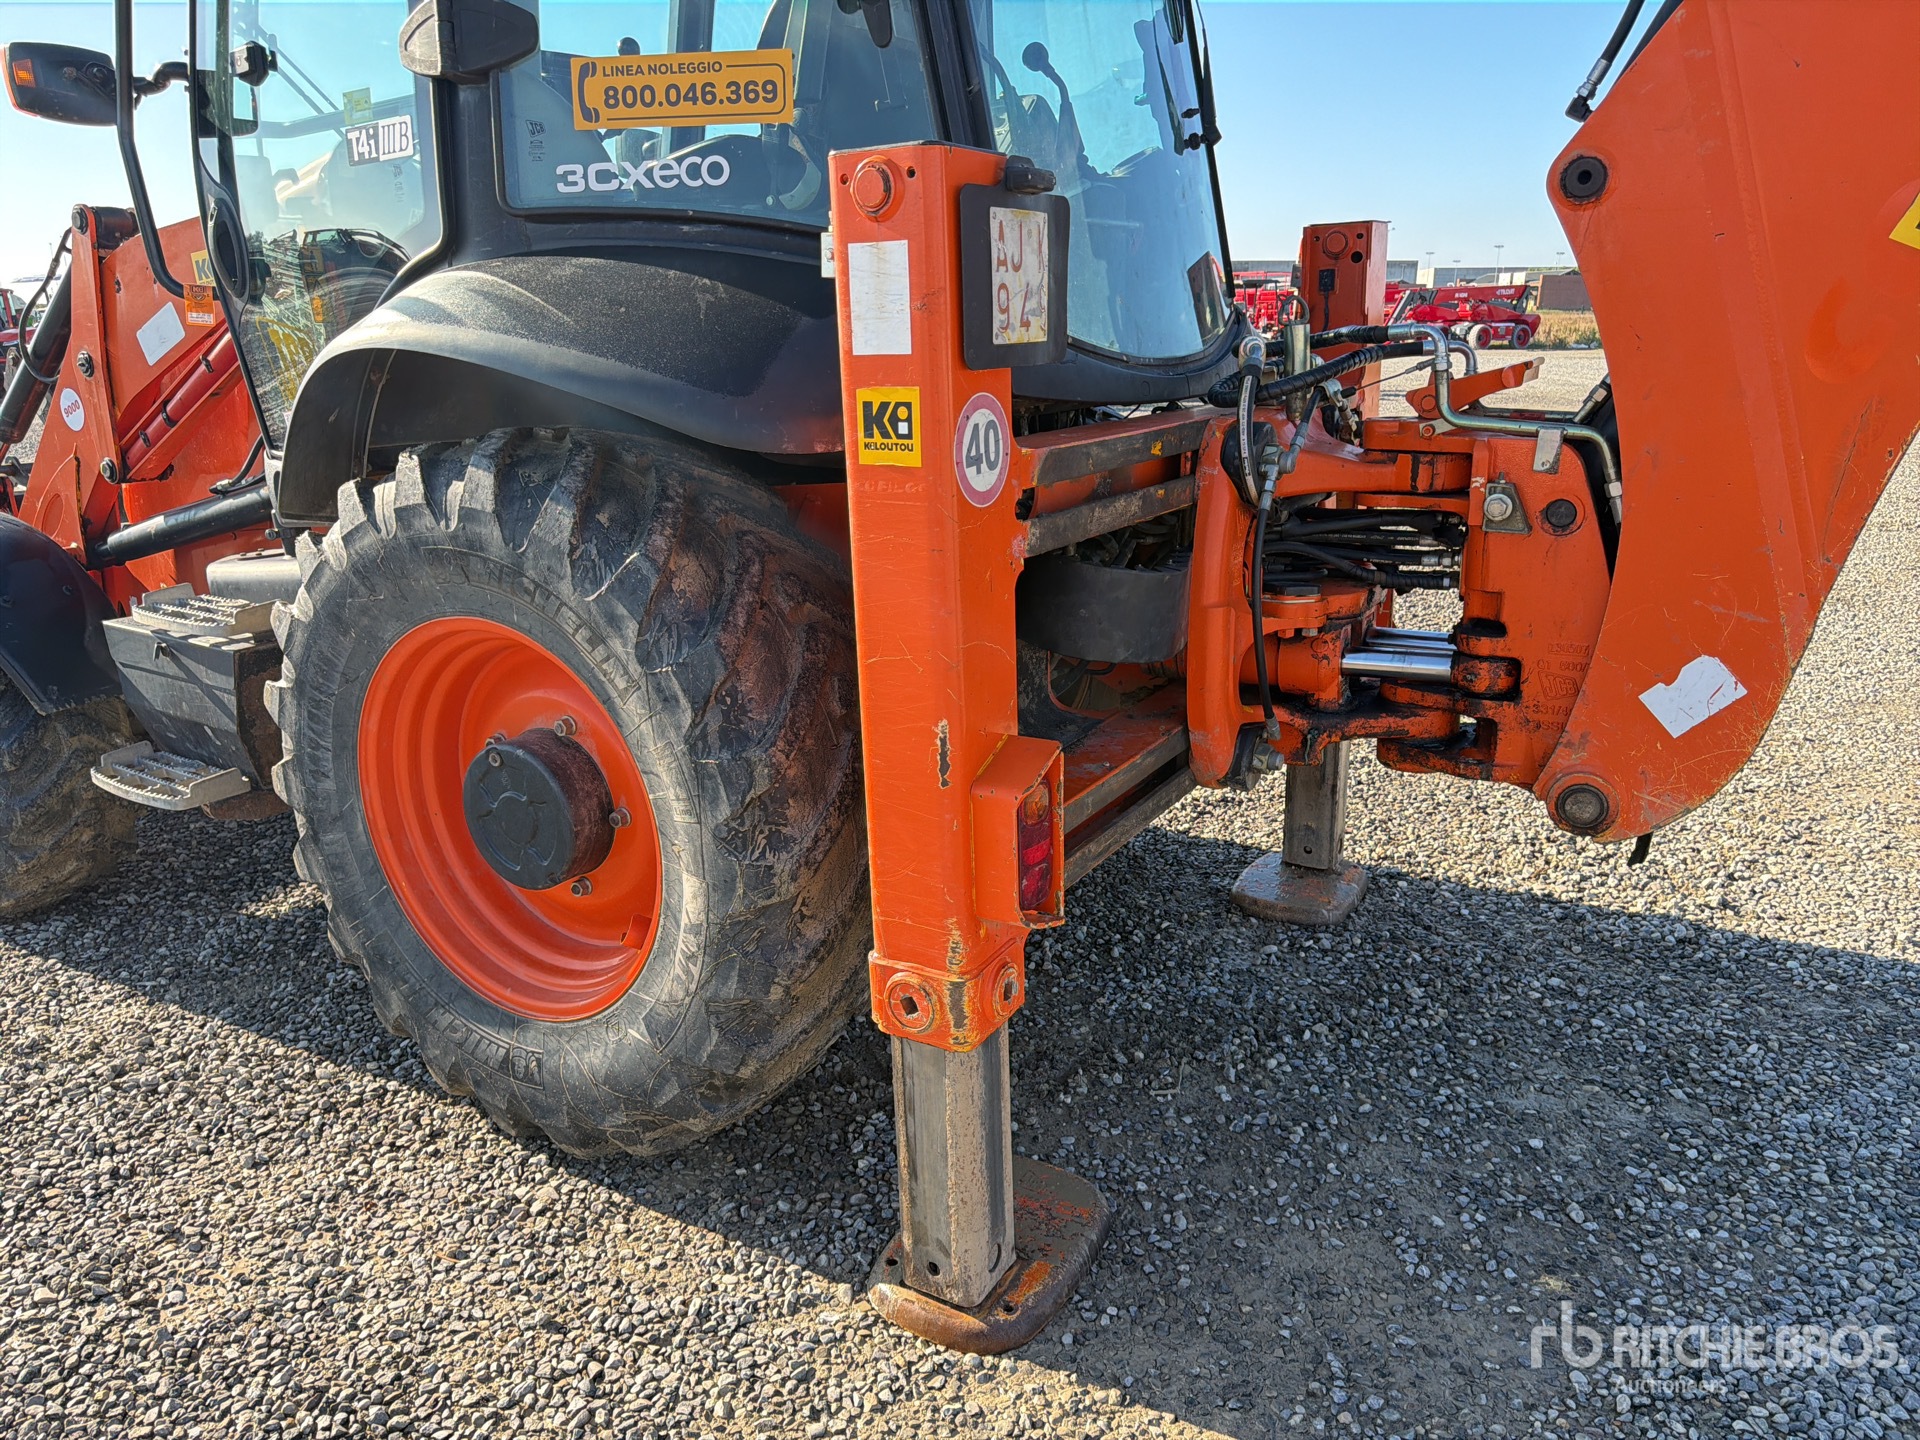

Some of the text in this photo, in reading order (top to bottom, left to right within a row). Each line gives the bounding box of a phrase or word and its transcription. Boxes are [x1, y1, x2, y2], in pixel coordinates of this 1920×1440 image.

[602, 60, 723, 78] LINEA NOLEGGIO
[602, 78, 779, 110] 800.046.369
[528, 120, 546, 136] JCB
[347, 128, 378, 162] T4i
[63, 399, 81, 418] 9000
[965, 419, 1000, 476] 40
[1545, 674, 1577, 697] JCB
